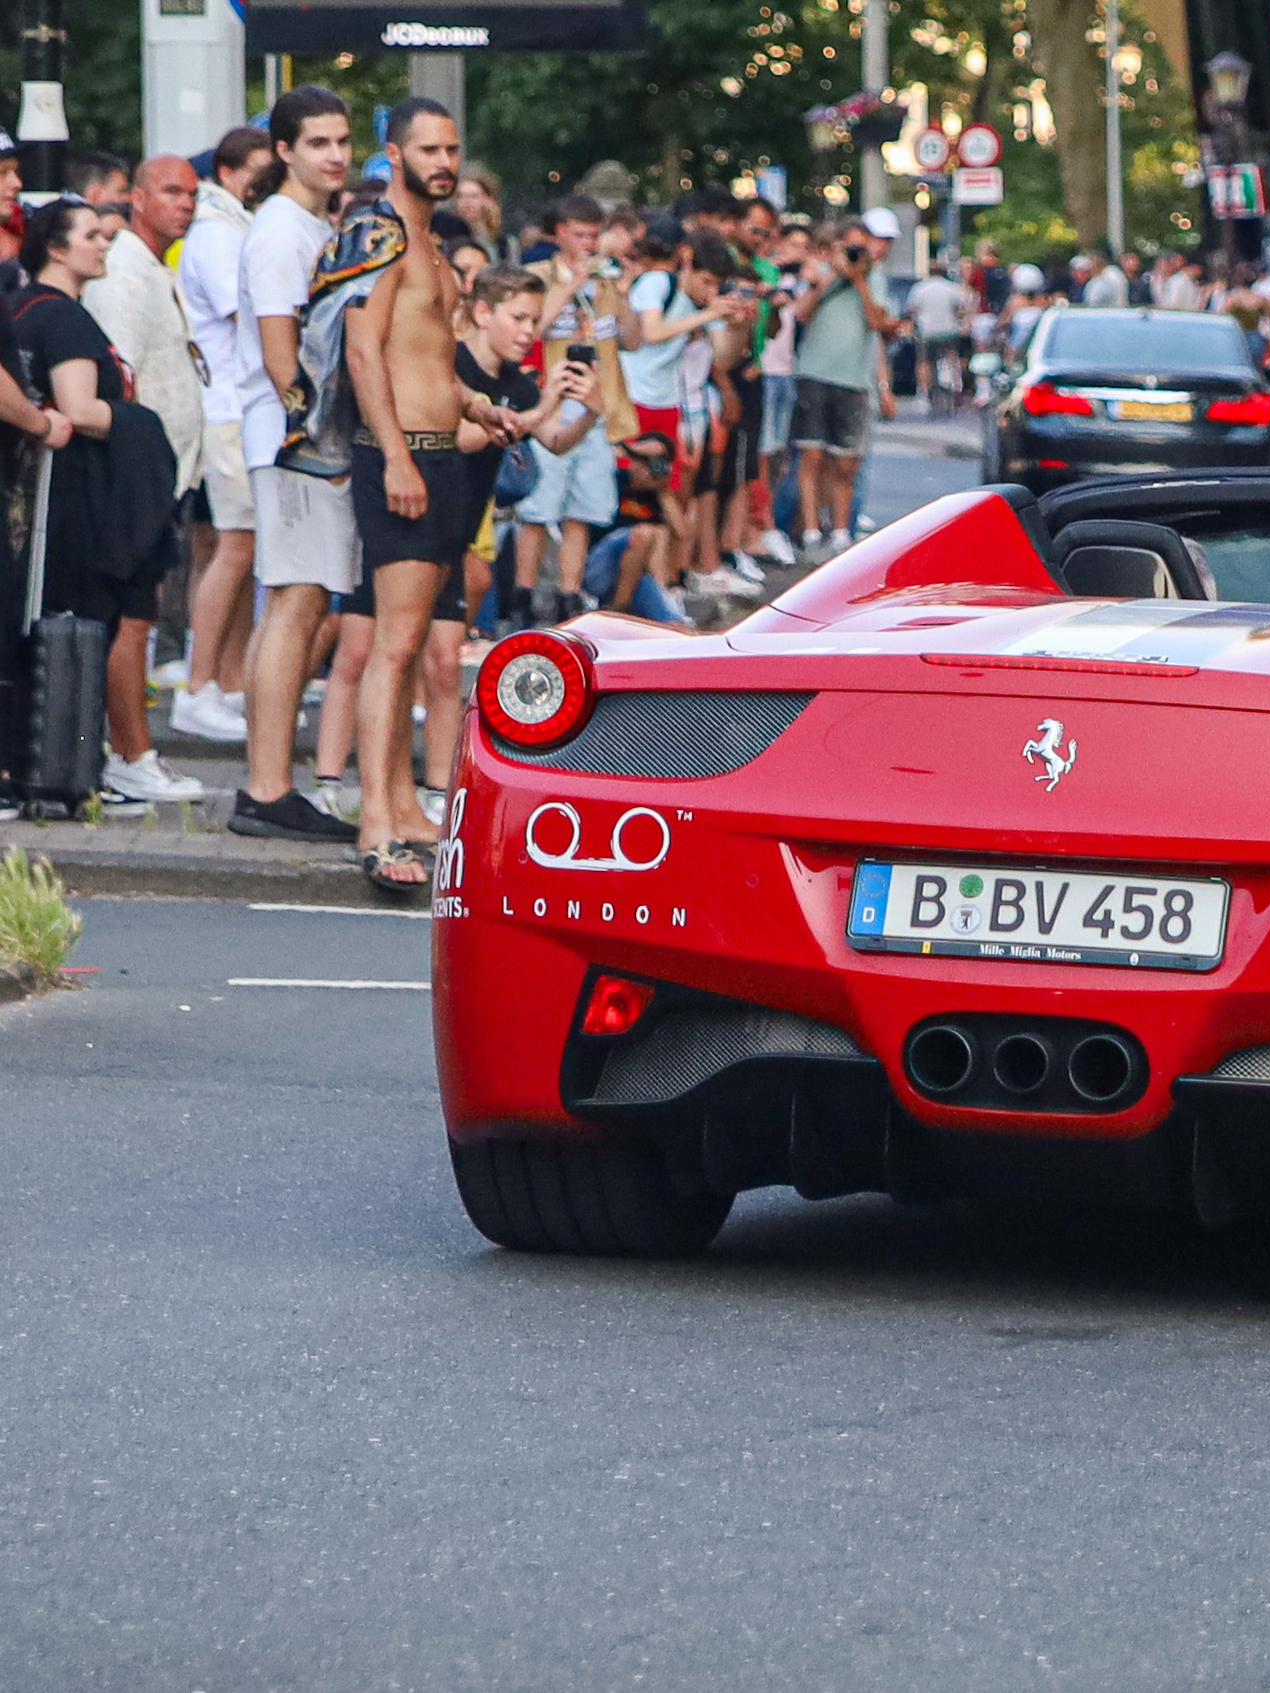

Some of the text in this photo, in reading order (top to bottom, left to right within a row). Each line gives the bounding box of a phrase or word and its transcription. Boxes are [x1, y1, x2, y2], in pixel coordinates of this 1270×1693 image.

[503, 896, 686, 927] LONDON
[862, 907, 875, 924] D
[910, 874, 1195, 944] B BV 458
[979, 944, 1082, 960] Mille Miglia Motors
